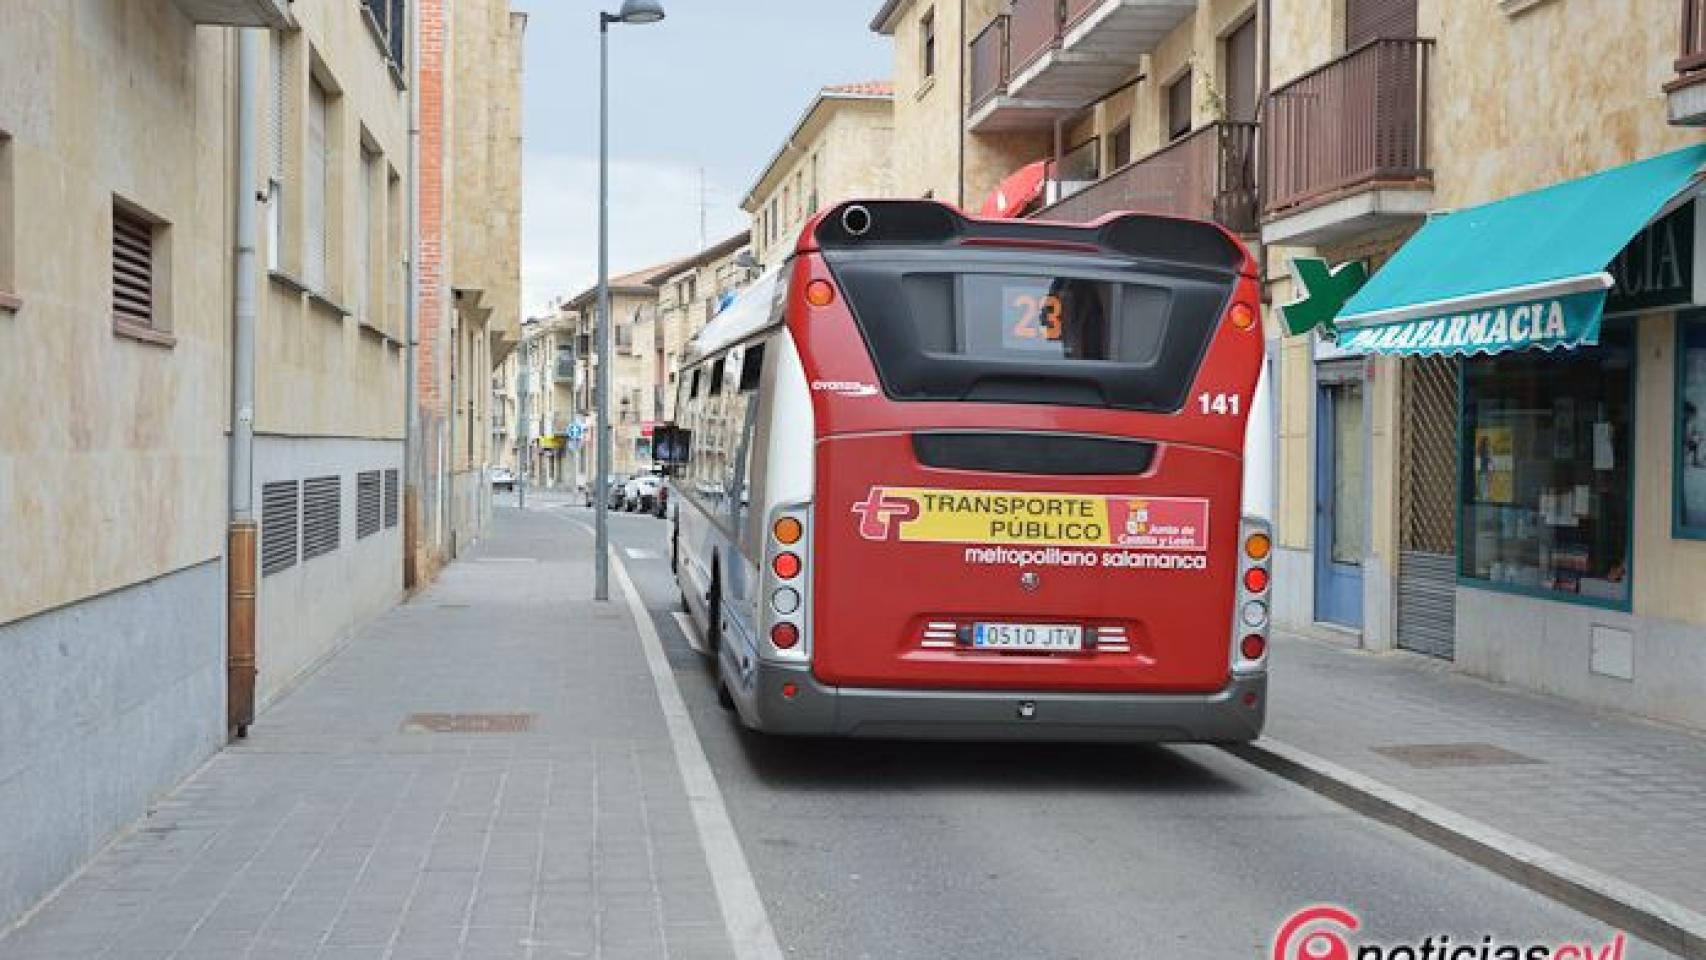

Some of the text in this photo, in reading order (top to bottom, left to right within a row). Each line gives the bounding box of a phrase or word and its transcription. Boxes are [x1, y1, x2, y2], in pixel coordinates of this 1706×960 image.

[1013, 295, 1062, 340] 23
[1348, 300, 1567, 349] PARAFARMACIA
[1198, 392, 1240, 416] 141
[923, 494, 1095, 518] TRANSPORTE
[989, 516, 1102, 541] PÚBLICO
[964, 546, 1207, 569] metropolitano salamanca
[986, 626, 1077, 646] 0510 JTV
